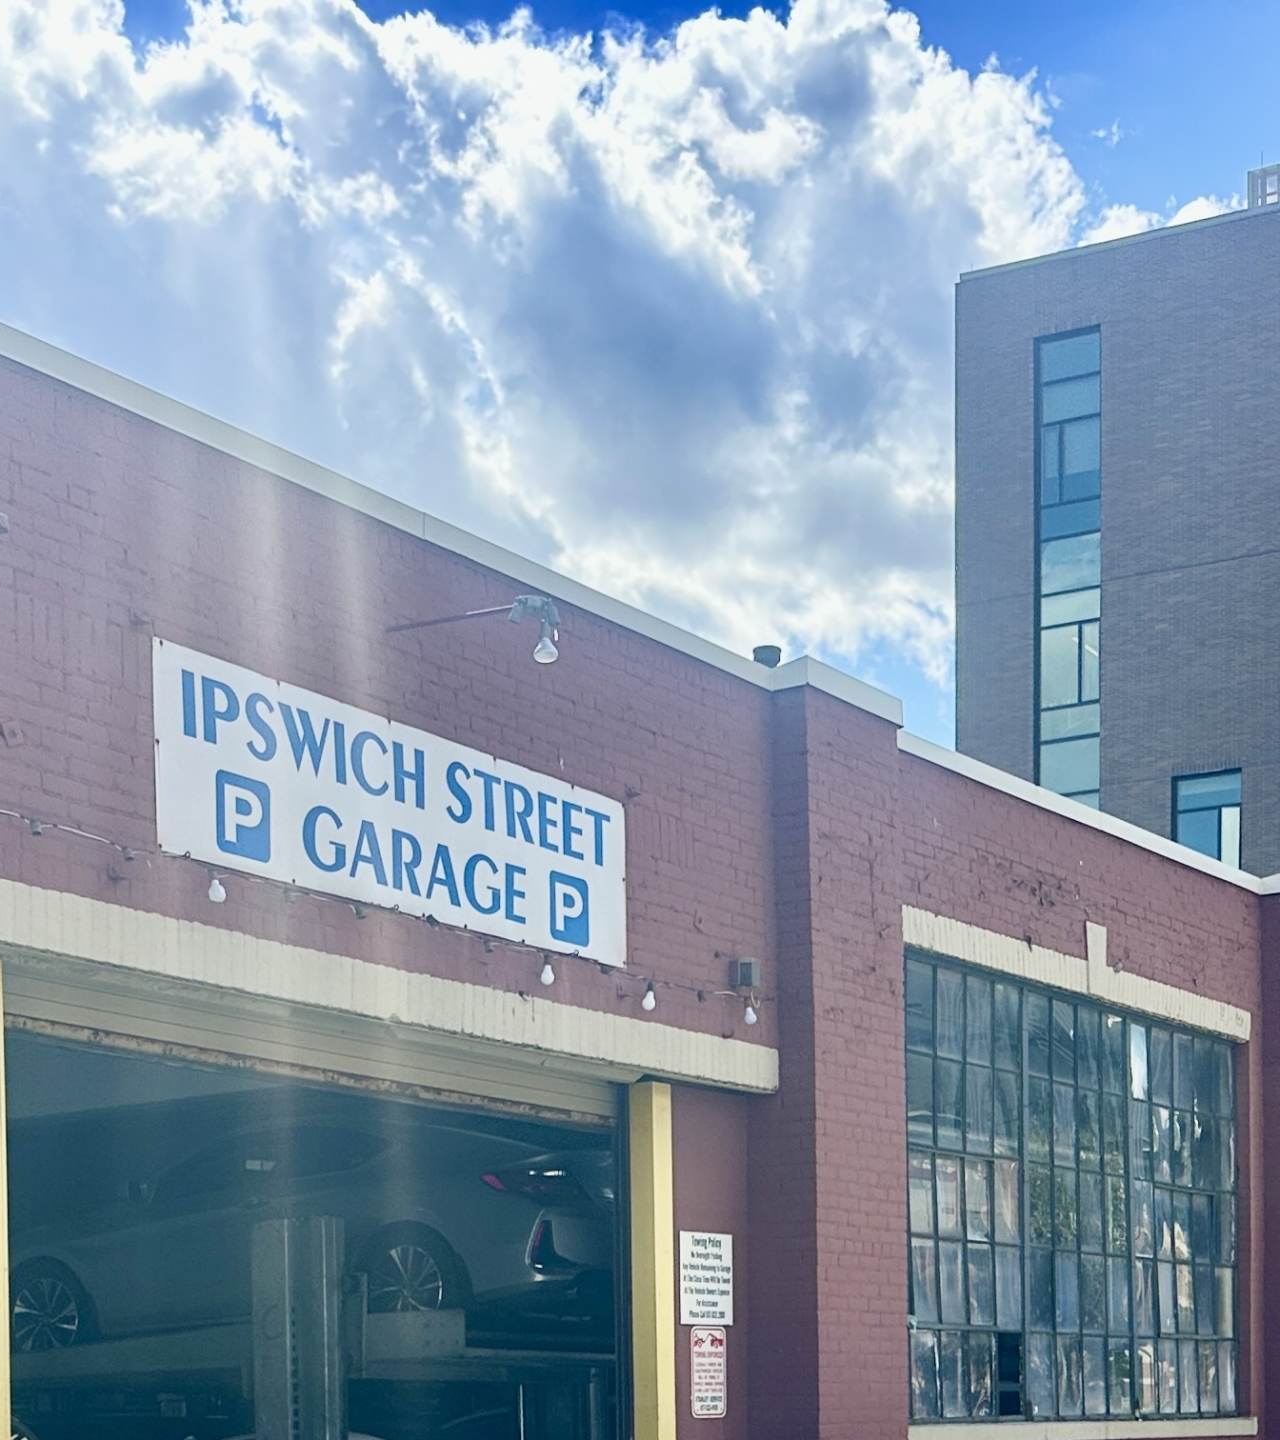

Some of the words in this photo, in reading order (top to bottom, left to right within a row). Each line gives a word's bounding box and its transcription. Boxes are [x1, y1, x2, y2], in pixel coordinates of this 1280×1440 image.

[181, 669, 425, 810] IPSWICH
[446, 761, 611, 866] STREET
[302, 805, 526, 924] GARAGE
